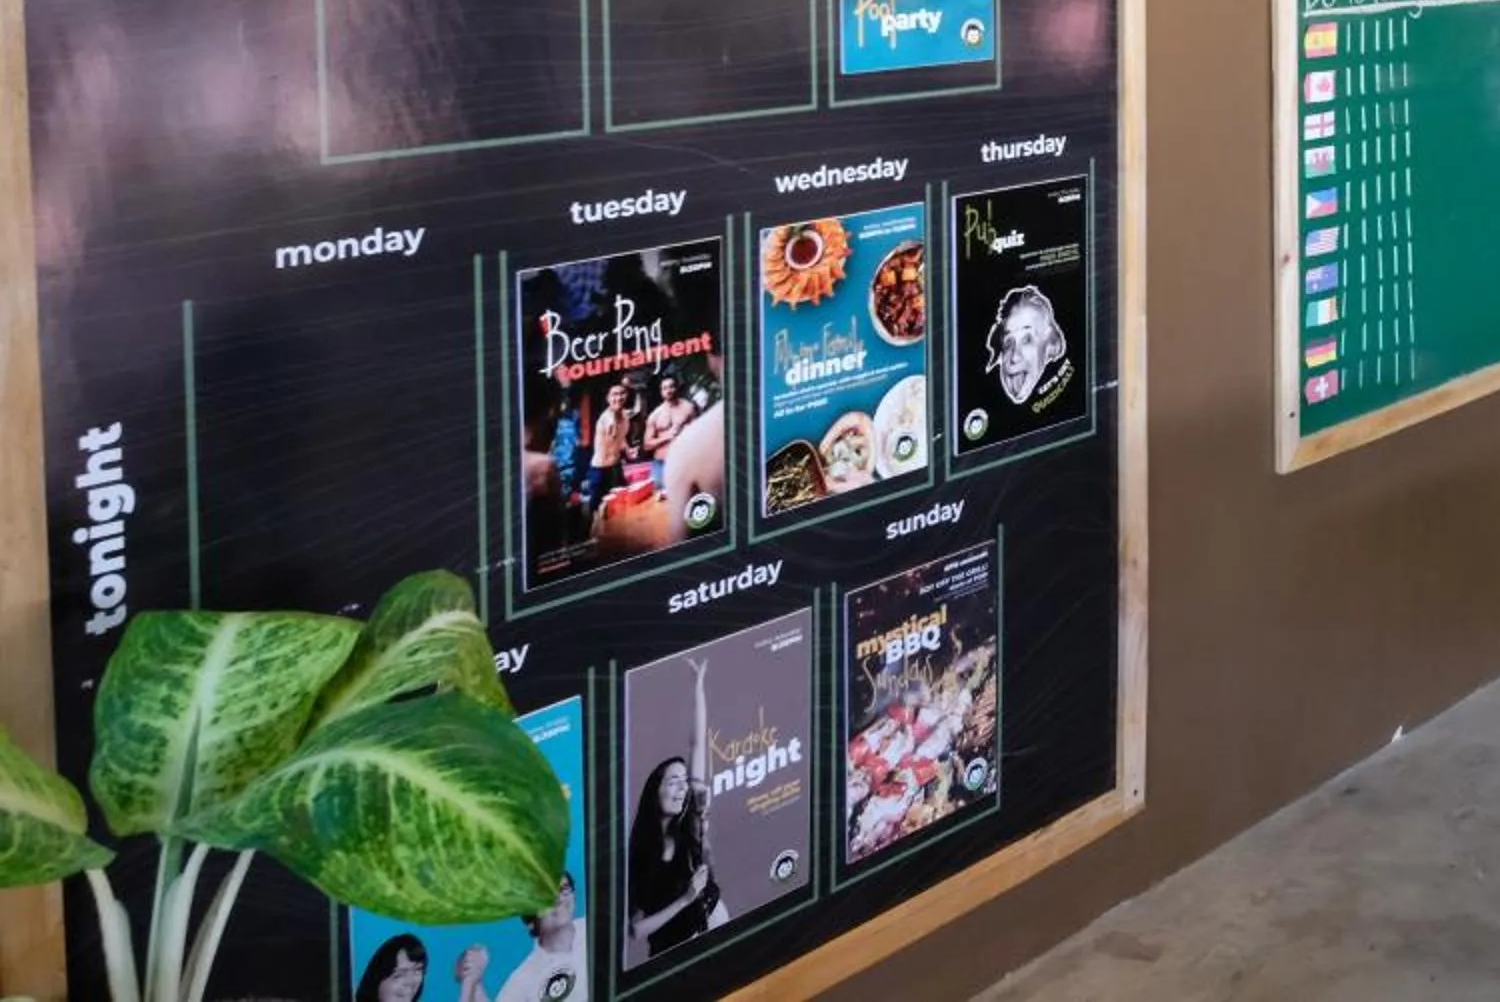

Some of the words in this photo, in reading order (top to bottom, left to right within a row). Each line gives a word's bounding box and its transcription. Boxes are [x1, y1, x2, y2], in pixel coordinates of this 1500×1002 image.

[880, 7, 942, 37] party
[981, 134, 1067, 164] thursday
[775, 157, 909, 193] wednesday
[570, 186, 686, 226] tuesday
[275, 227, 425, 273] monday
[989, 230, 1026, 254] quiz
[538, 309, 608, 378] Beer
[612, 294, 662, 375] Pong
[554, 331, 713, 384] tournament
[785, 349, 869, 388] dinner
[72, 422, 136, 636] tonight
[886, 500, 965, 540] sunday
[668, 560, 782, 614] saturday
[856, 603, 947, 660] mystical
[886, 625, 941, 665] BBQ
[708, 706, 778, 777] Karaoke
[713, 736, 803, 798] night
